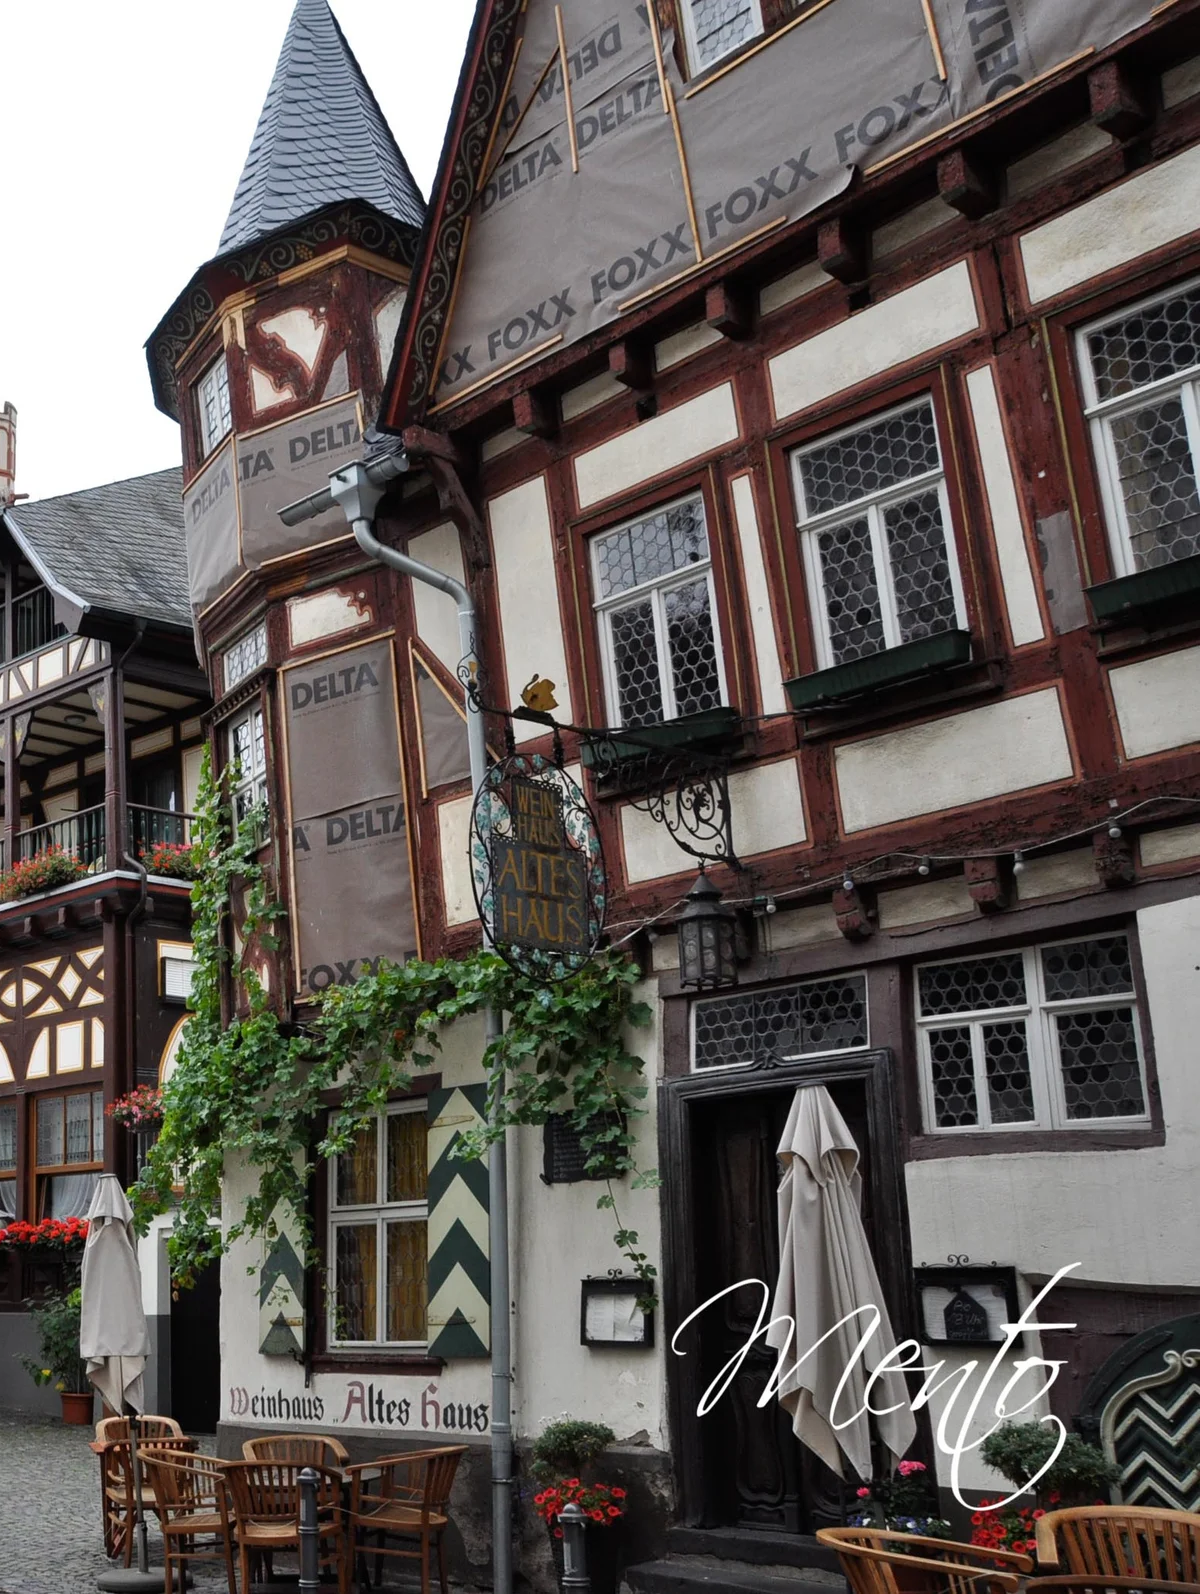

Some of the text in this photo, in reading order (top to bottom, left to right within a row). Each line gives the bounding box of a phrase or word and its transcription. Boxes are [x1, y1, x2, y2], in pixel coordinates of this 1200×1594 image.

[487, 286, 576, 362] FOXX
[590, 222, 692, 305] FOXX
[705, 146, 819, 239] FOXX
[517, 814, 561, 847] HAUS
[498, 849, 582, 901] ALTES
[501, 893, 585, 946] HAUS
[230, 1386, 324, 1423] Weinhaus
[421, 1383, 490, 1433] Haus
